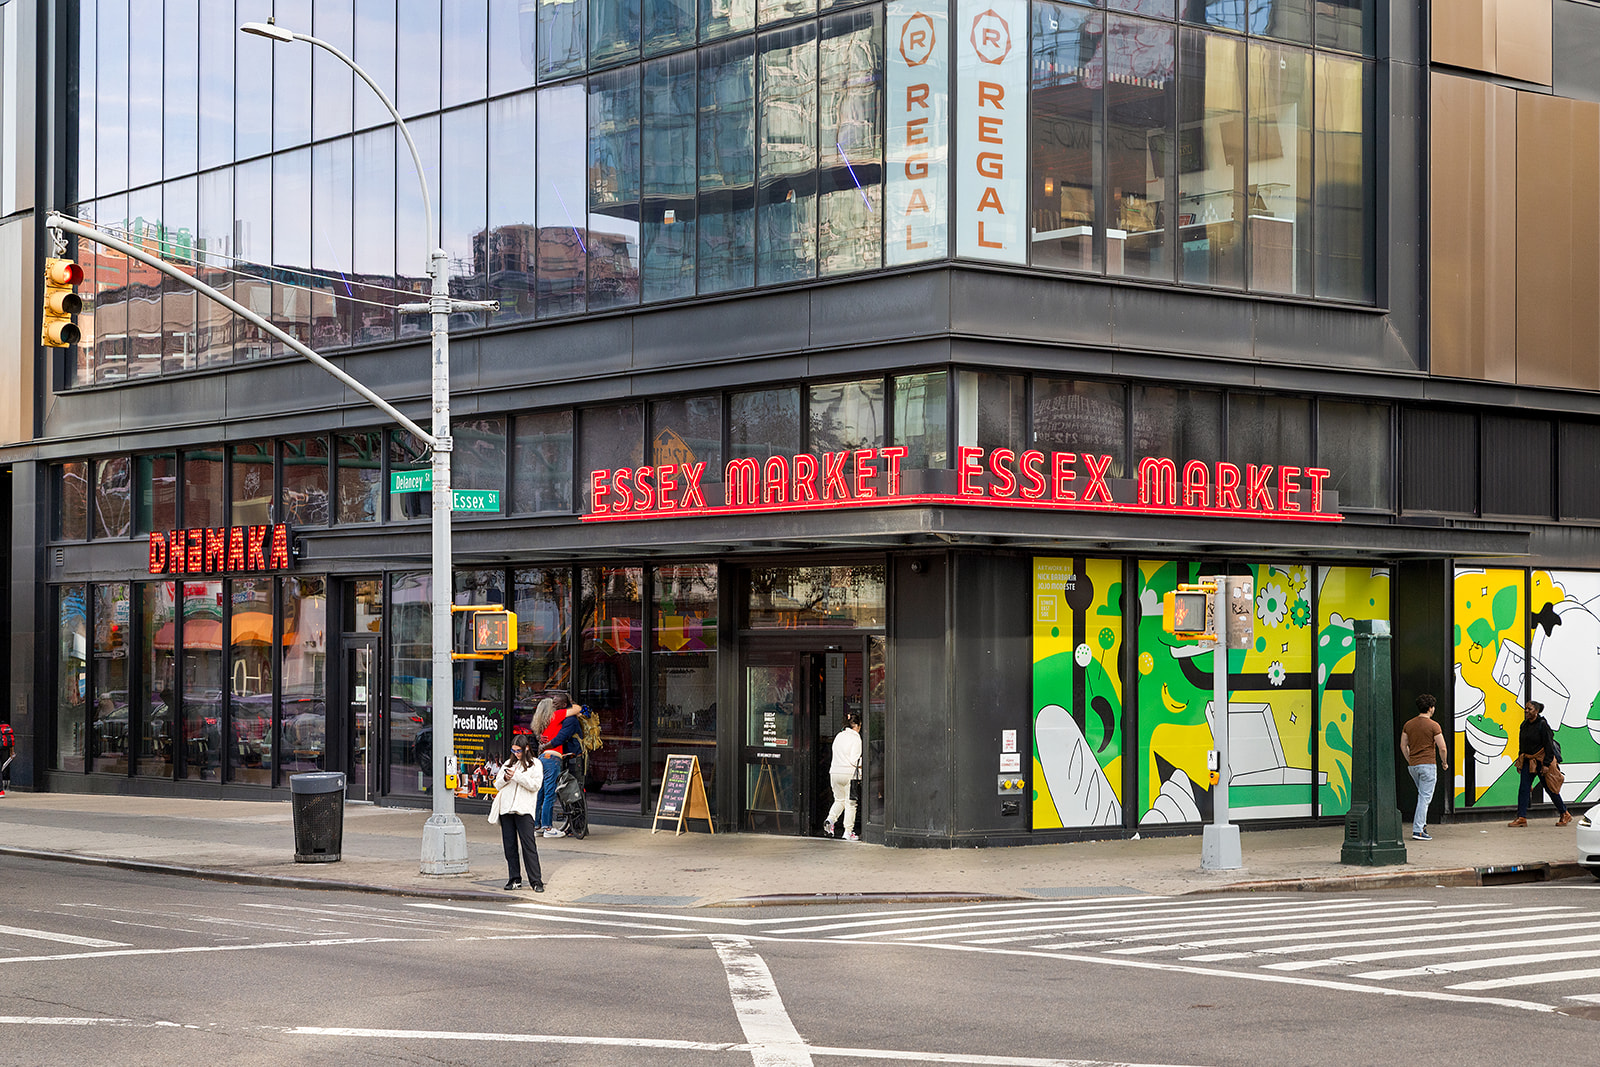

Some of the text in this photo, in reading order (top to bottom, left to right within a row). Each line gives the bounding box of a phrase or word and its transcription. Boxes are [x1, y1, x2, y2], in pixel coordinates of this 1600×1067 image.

[904, 82, 931, 251] REGAL
[976, 80, 1005, 250] REGAL
[396, 472, 431, 491] Delancey St
[454, 492, 496, 509] Essex St
[590, 446, 909, 514] ESSEX MARKET
[957, 445, 1331, 513] ESSEX MARKET
[494, 620, 507, 645] 30
[453, 715, 475, 729] Fresh
[477, 715, 498, 730] Bites
